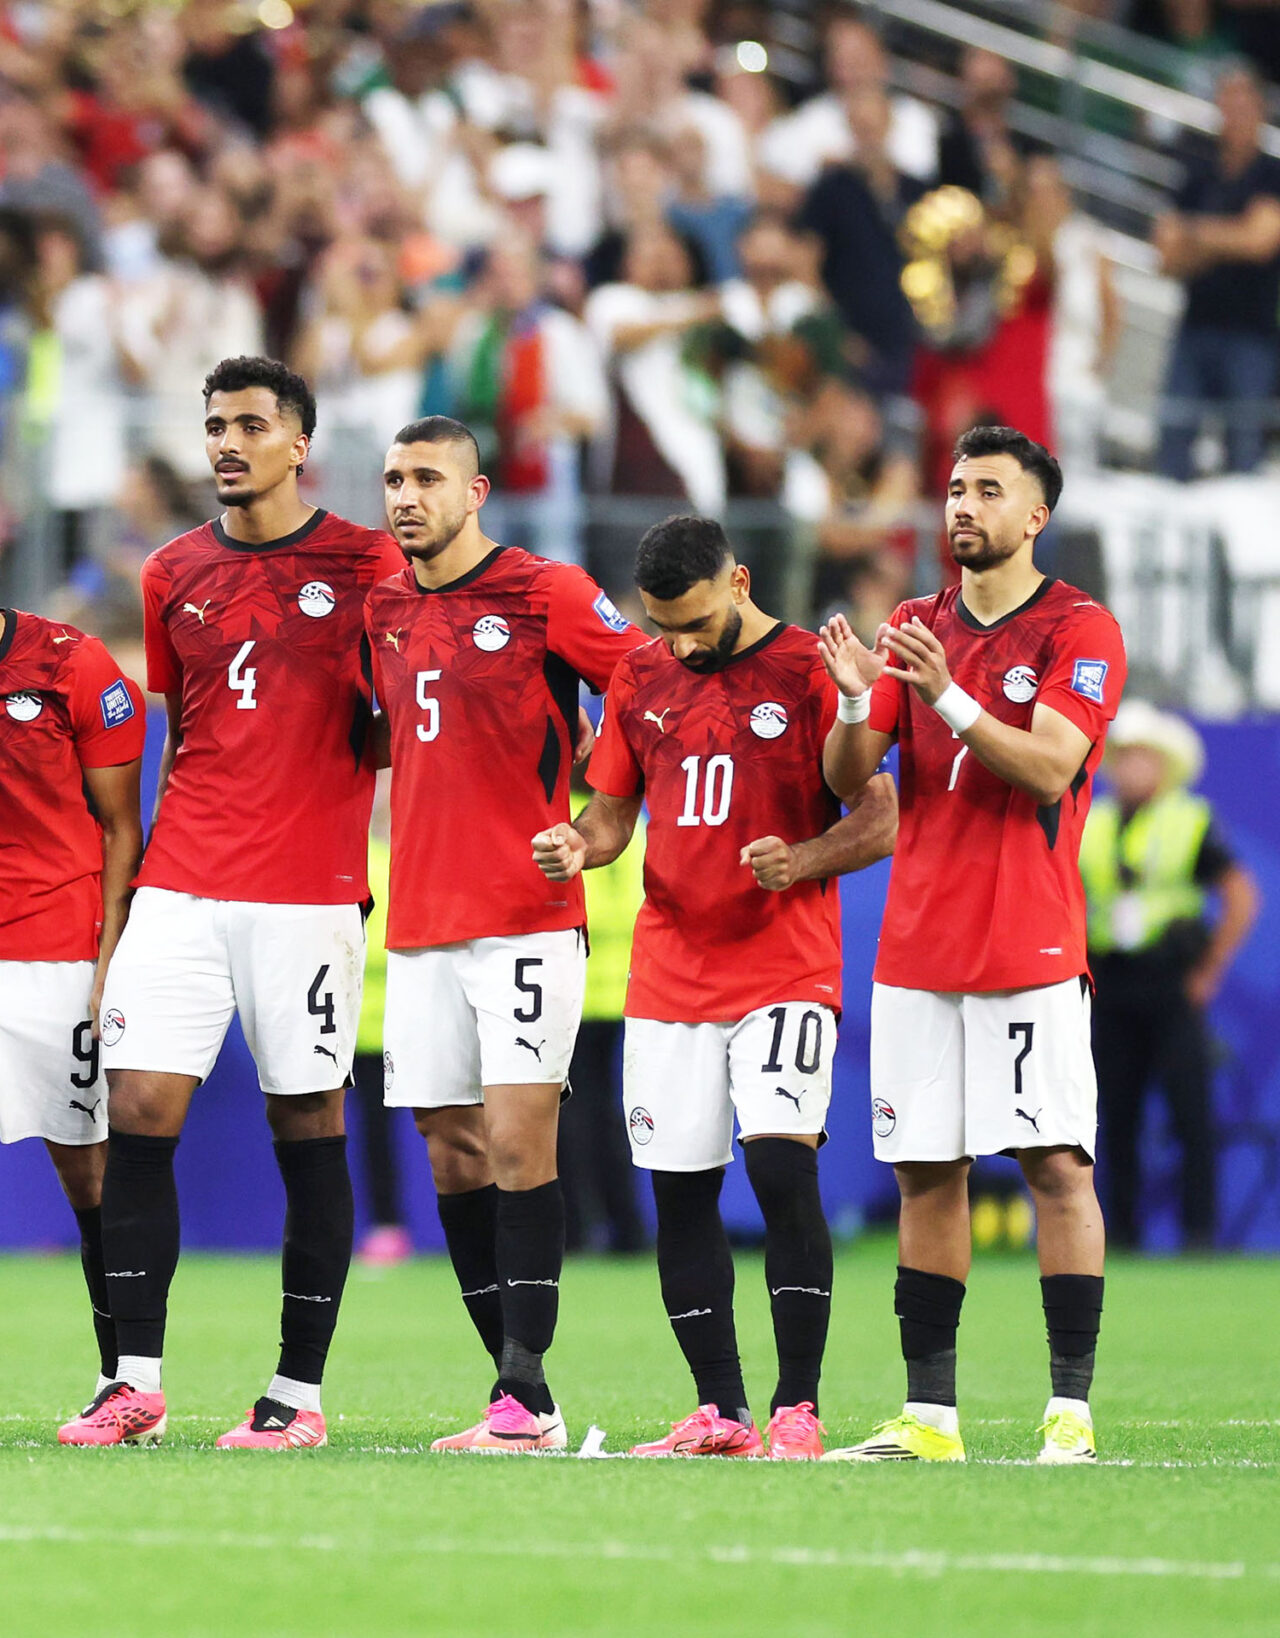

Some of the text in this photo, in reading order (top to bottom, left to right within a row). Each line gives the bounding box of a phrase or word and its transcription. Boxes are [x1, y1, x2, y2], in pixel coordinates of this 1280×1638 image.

[227, 640, 257, 710] 4
[415, 669, 443, 743] 5
[676, 754, 734, 827] 10
[307, 964, 337, 1035] 4
[513, 957, 543, 1023] 5
[69, 1020, 100, 1089] 9
[761, 1007, 822, 1075] 10
[1008, 1022, 1035, 1094] 7
